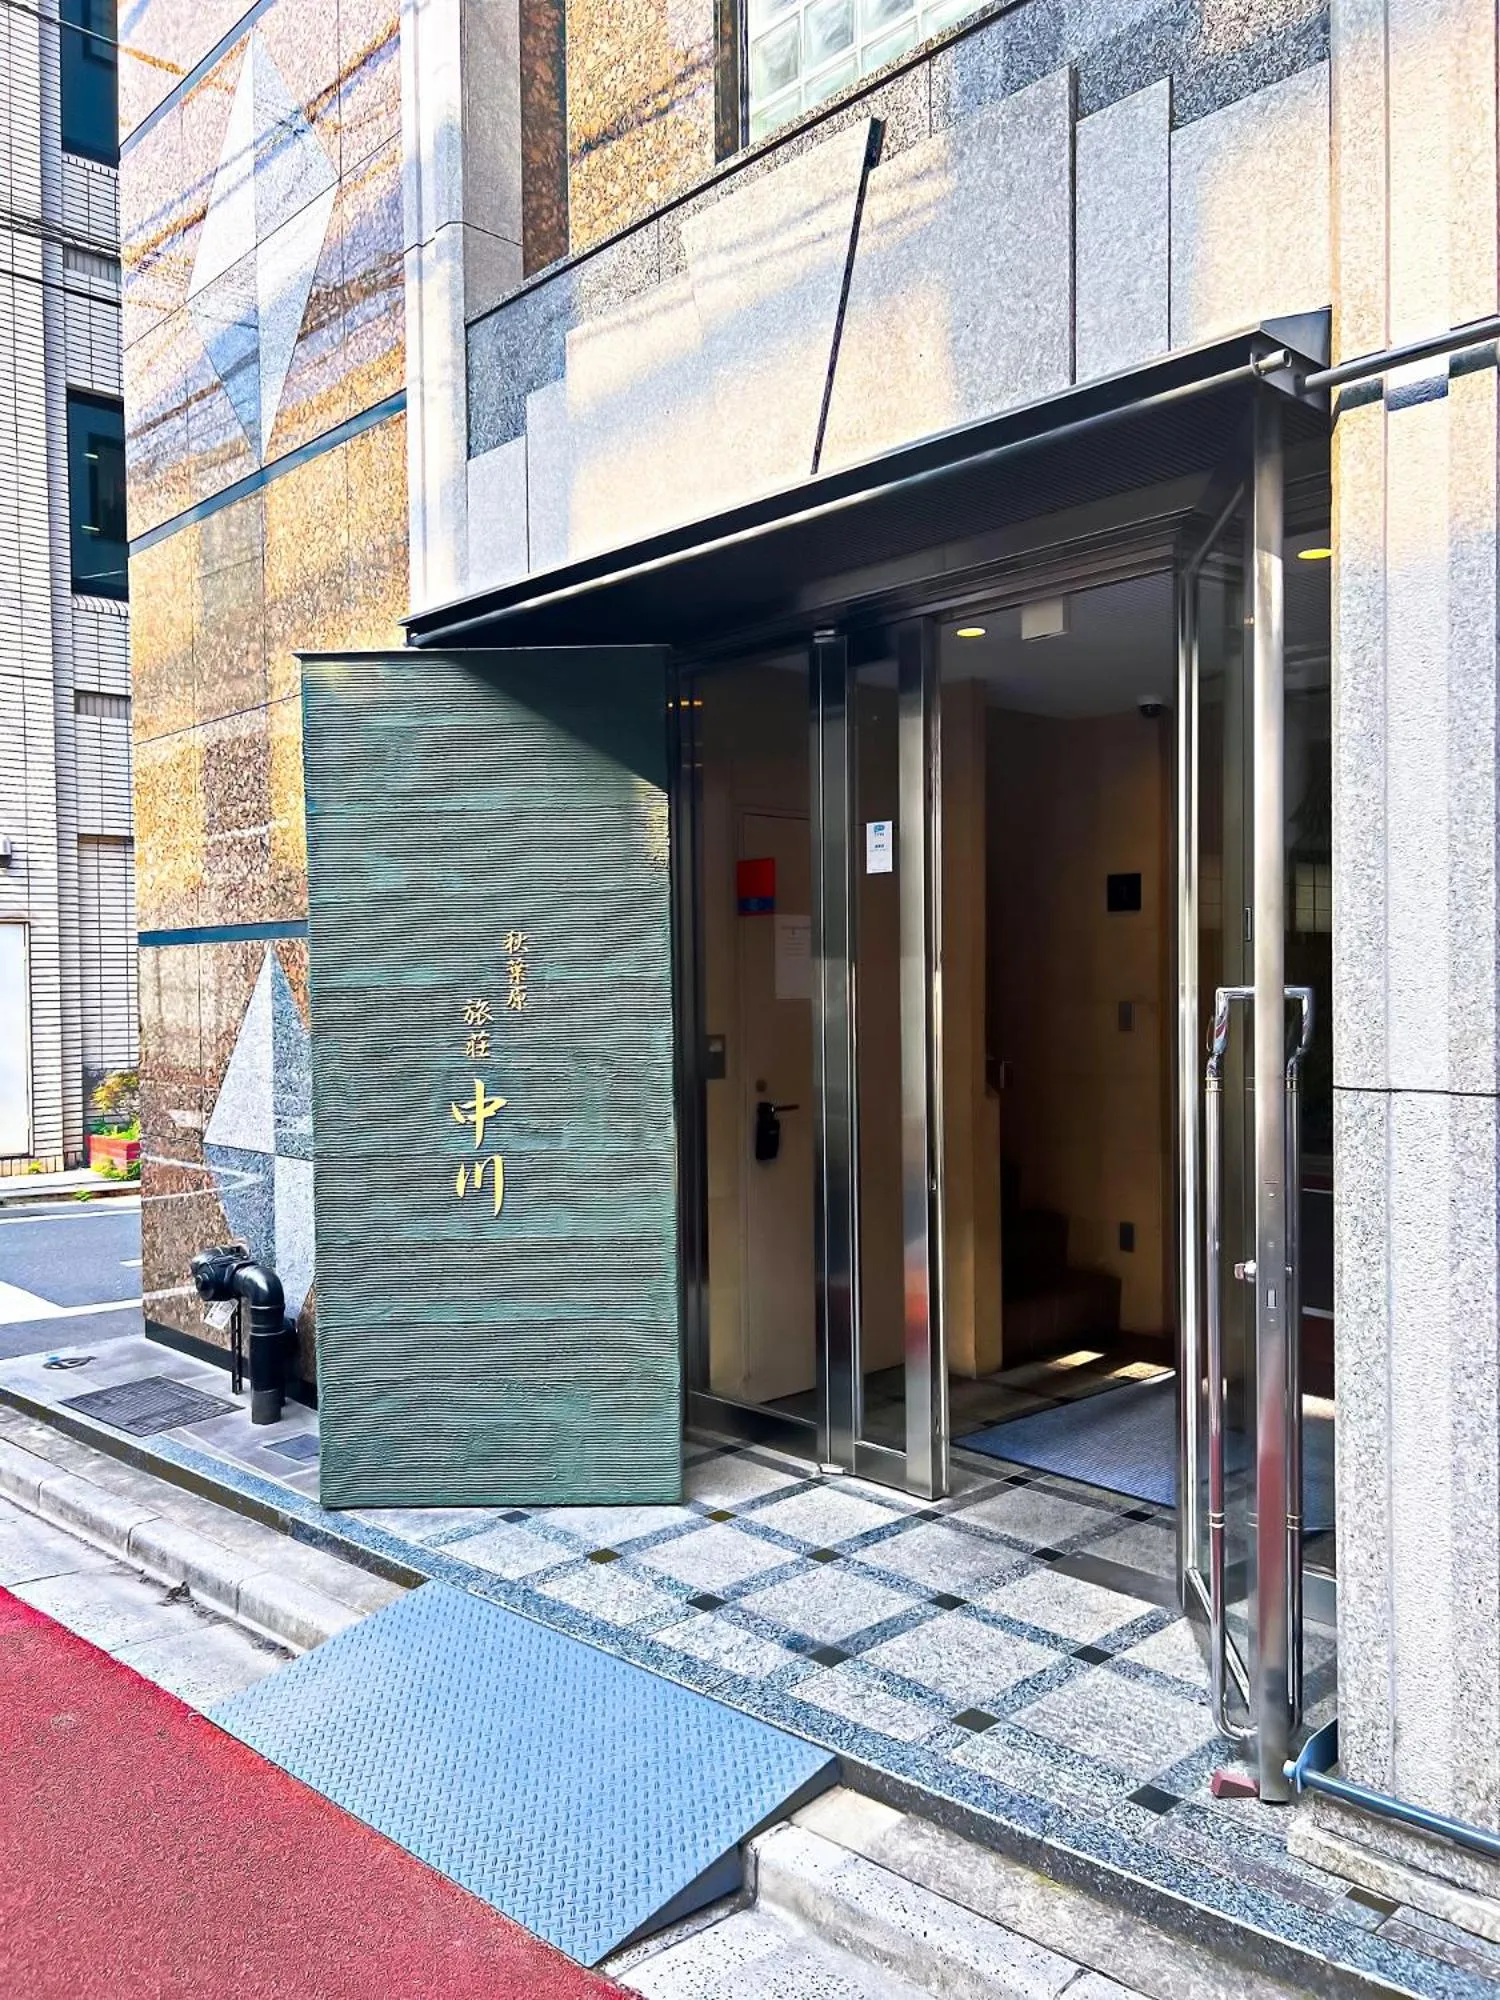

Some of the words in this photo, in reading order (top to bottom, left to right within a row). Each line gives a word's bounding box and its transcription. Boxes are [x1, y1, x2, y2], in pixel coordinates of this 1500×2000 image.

[504, 930, 528, 1011] 秋葉原
[452, 1078, 508, 1216] 中川
